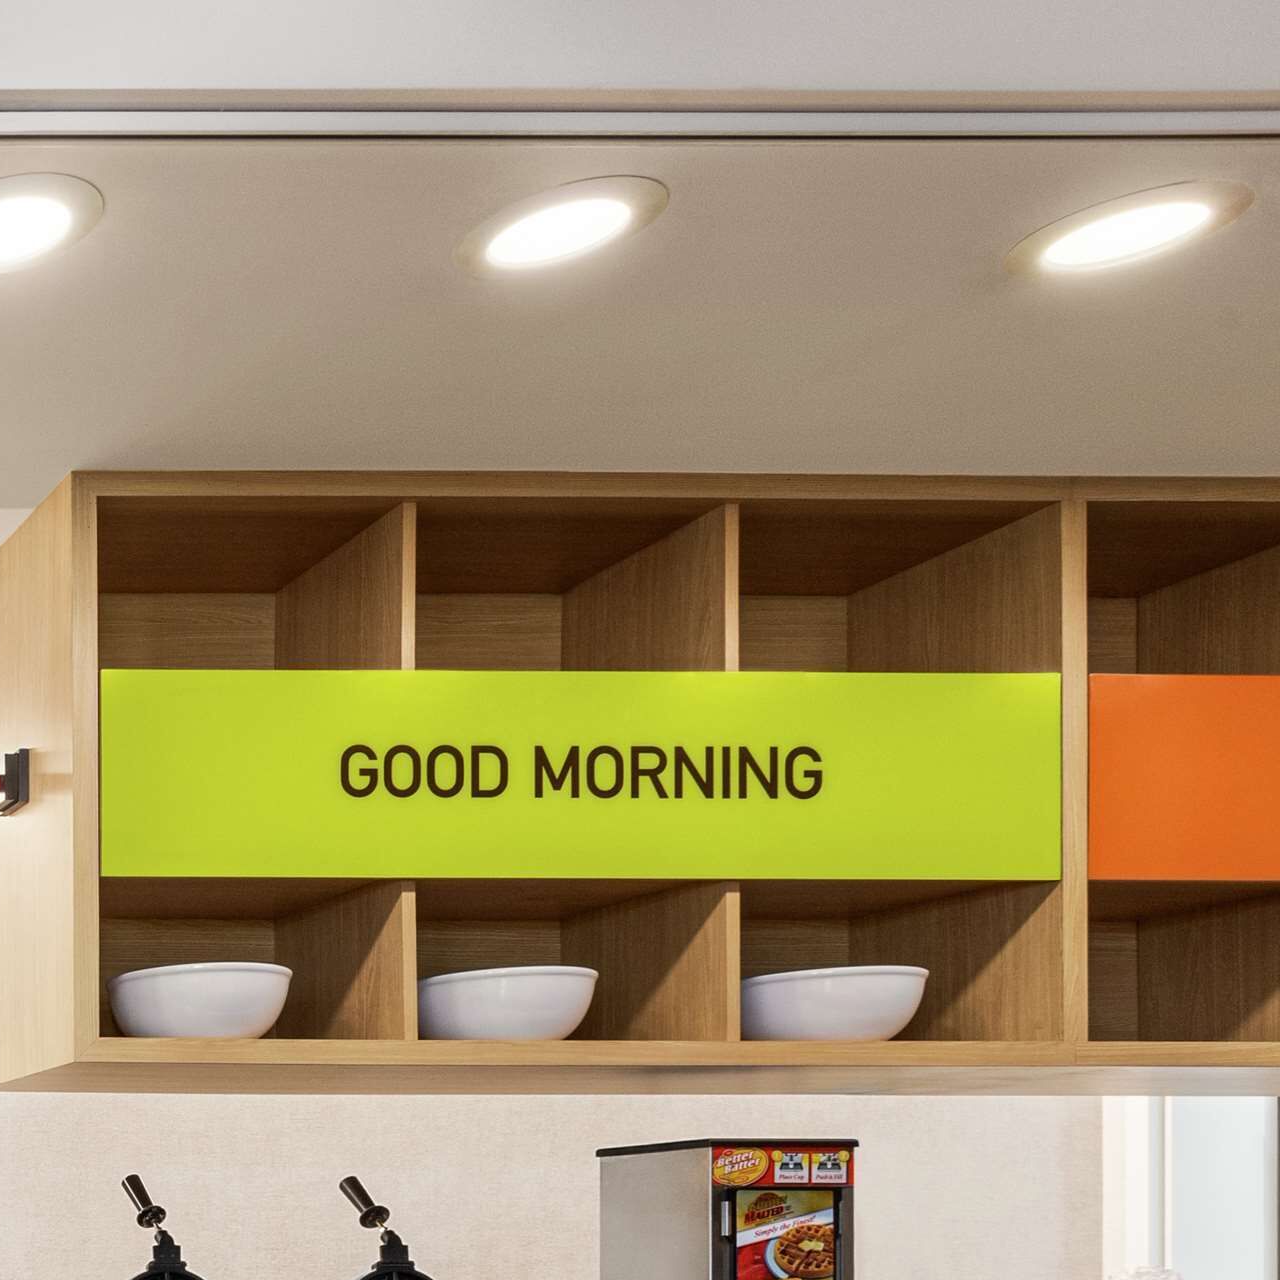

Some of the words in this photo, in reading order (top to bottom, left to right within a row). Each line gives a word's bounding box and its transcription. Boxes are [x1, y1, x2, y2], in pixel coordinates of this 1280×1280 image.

[340, 744, 509, 798] GOOD
[533, 744, 824, 800] MORNING
[717, 1151, 754, 1167] Better
[724, 1158, 761, 1174] Batter
